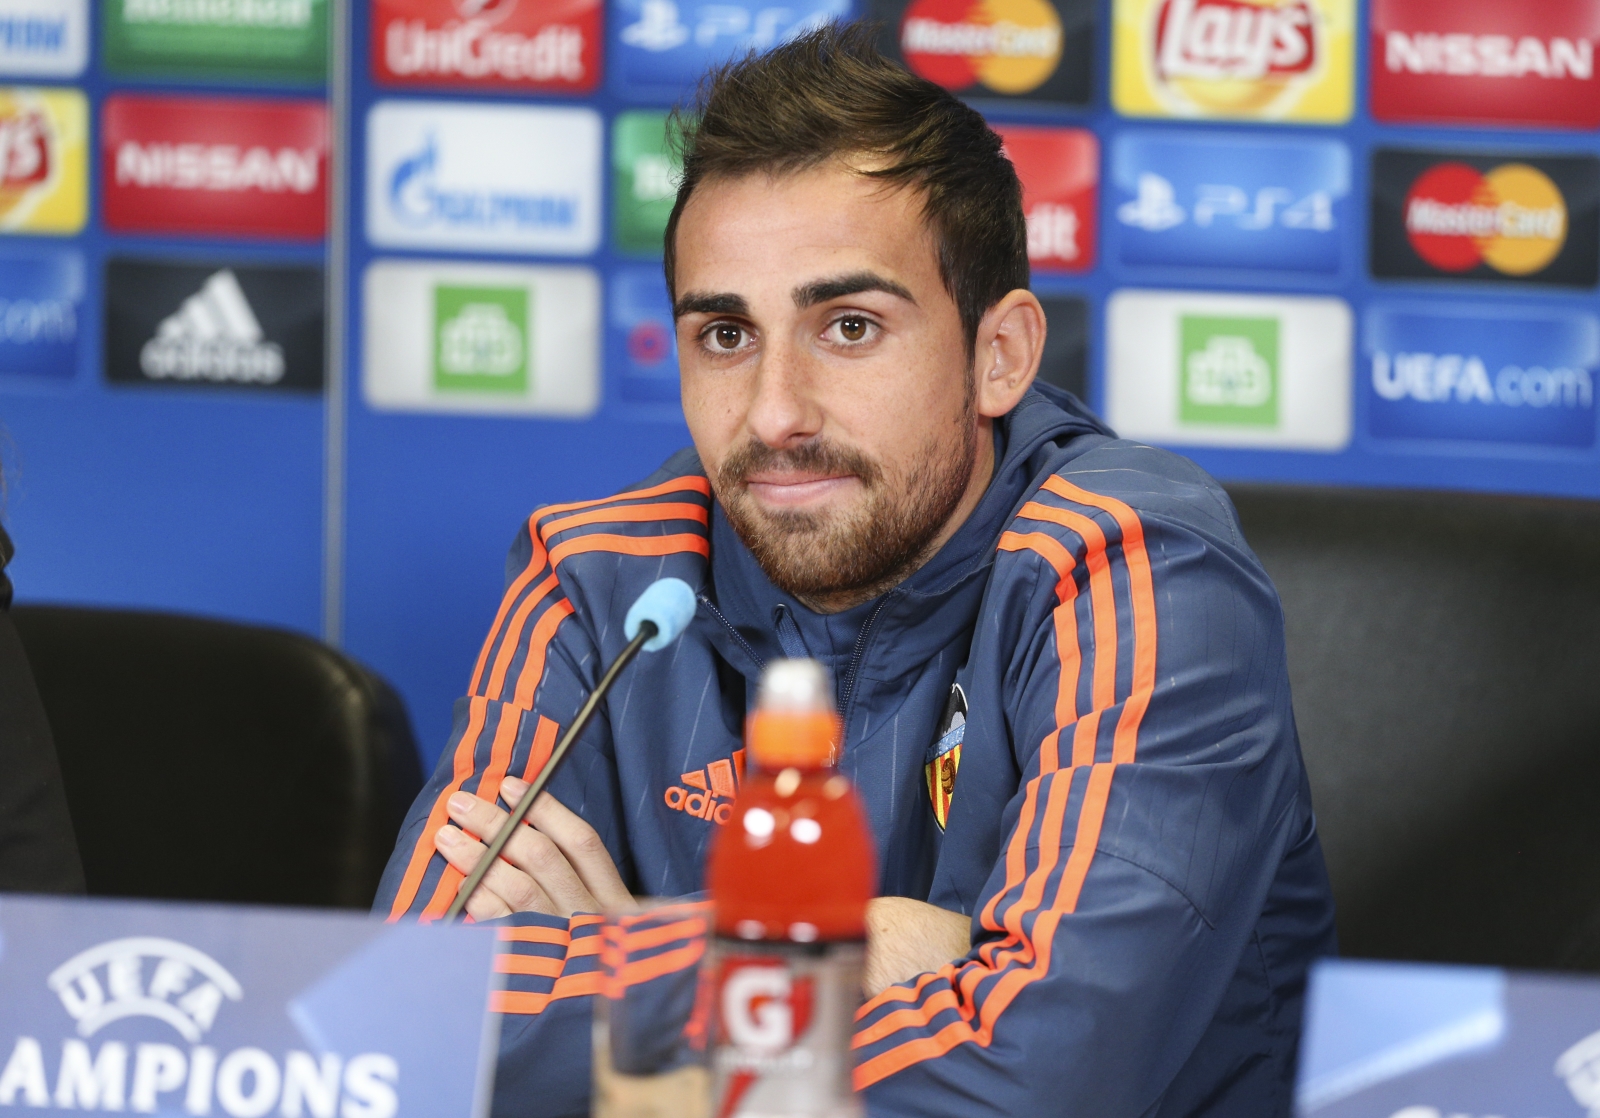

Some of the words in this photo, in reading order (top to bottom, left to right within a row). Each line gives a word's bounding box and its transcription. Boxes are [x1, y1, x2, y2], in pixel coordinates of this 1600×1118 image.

[385, 19, 585, 82] UniCredit
[903, 17, 1064, 59] MasterCard
[1384, 29, 1594, 81] NISSAN
[115, 139, 319, 195] NISSAN
[1191, 182, 1338, 233] PS4
[1404, 196, 1565, 242] MasterCard
[139, 338, 287, 385] adidas
[1371, 350, 1594, 408] UEFA.com
[56, 950, 225, 1034] UEFA
[720, 964, 796, 1054] G
[0, 1034, 401, 1118] AMPIONS
